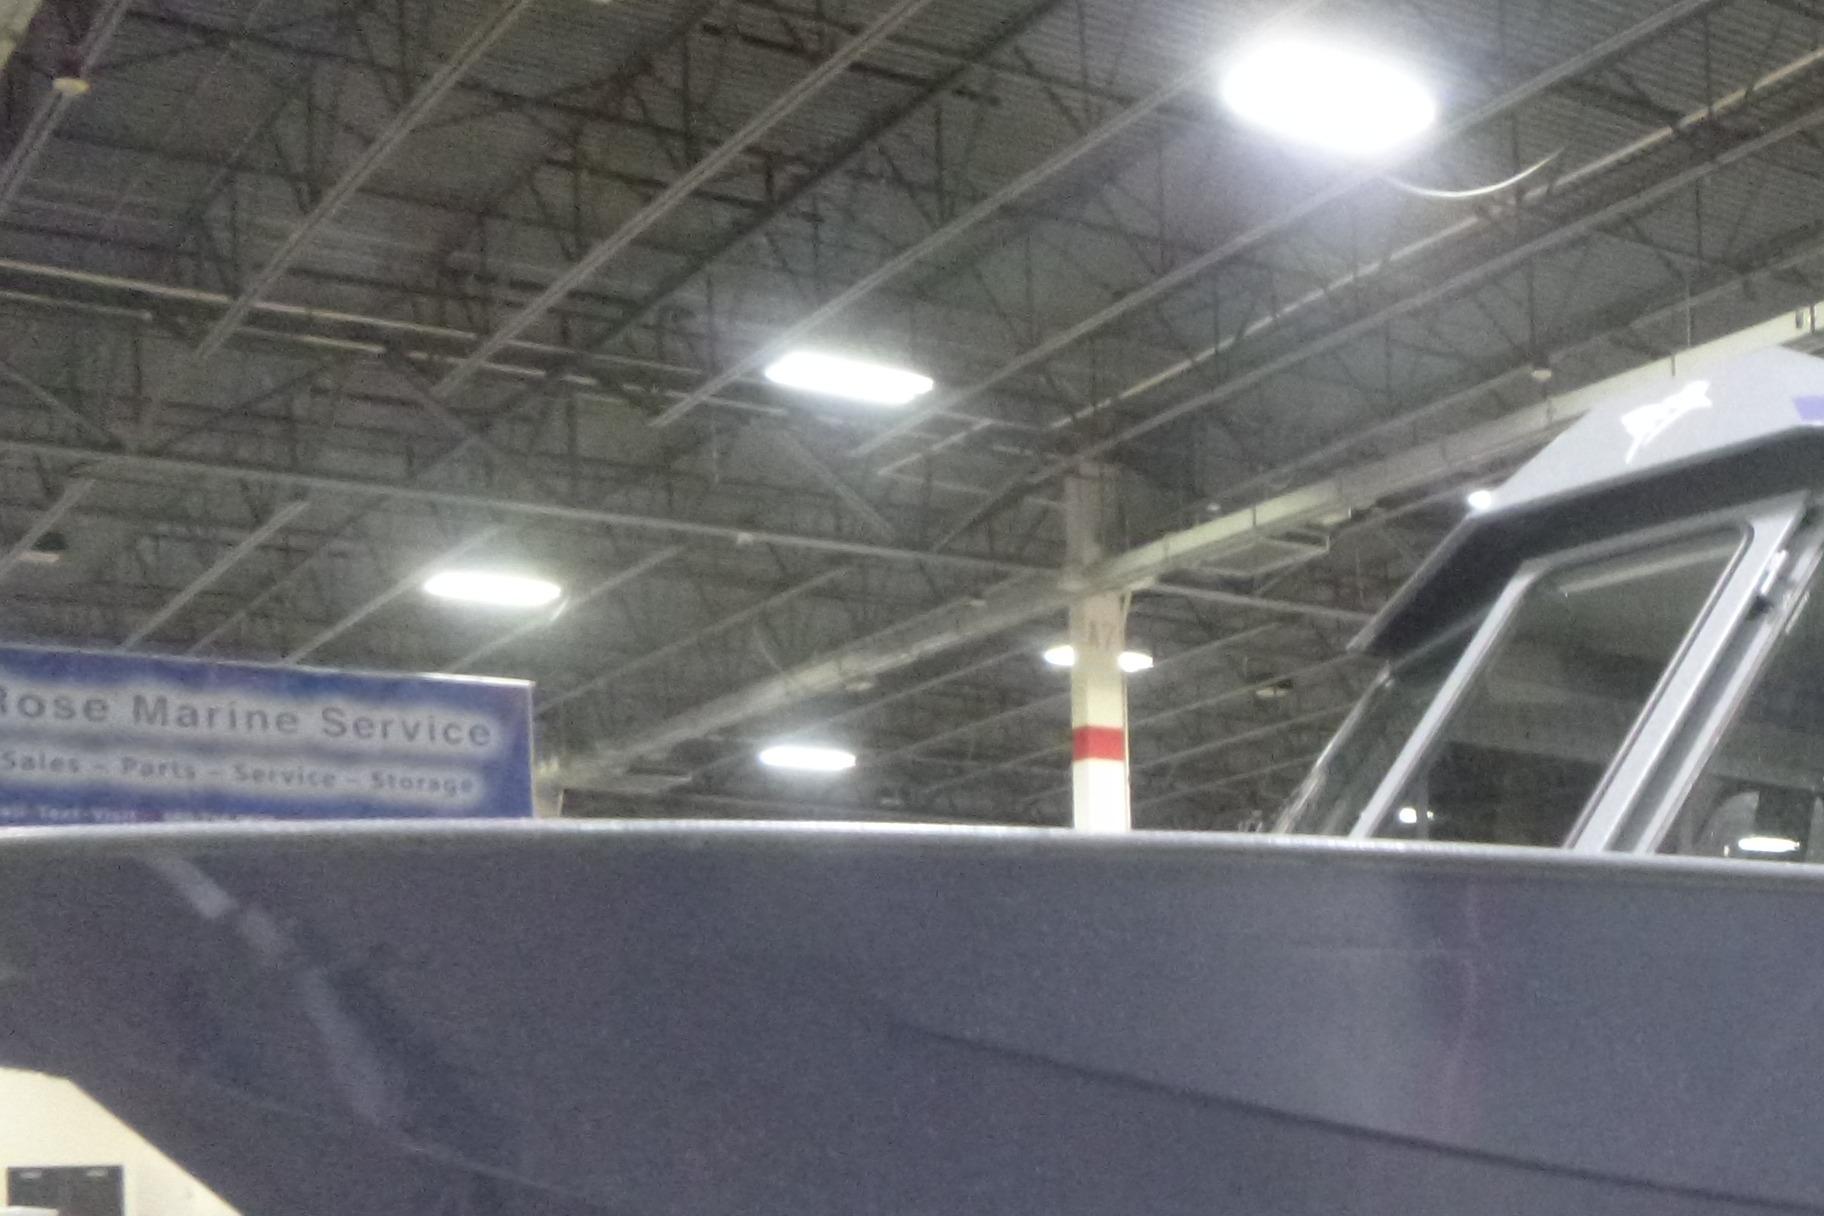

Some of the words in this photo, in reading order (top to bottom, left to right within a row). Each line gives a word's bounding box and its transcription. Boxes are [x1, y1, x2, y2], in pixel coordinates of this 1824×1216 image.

[131, 694, 299, 735] Marine
[320, 705, 491, 747] Service
[1, 750, 82, 776] Sales
[121, 755, 197, 781] Parts
[233, 763, 337, 790] Service
[370, 771, 473, 798] Storage
